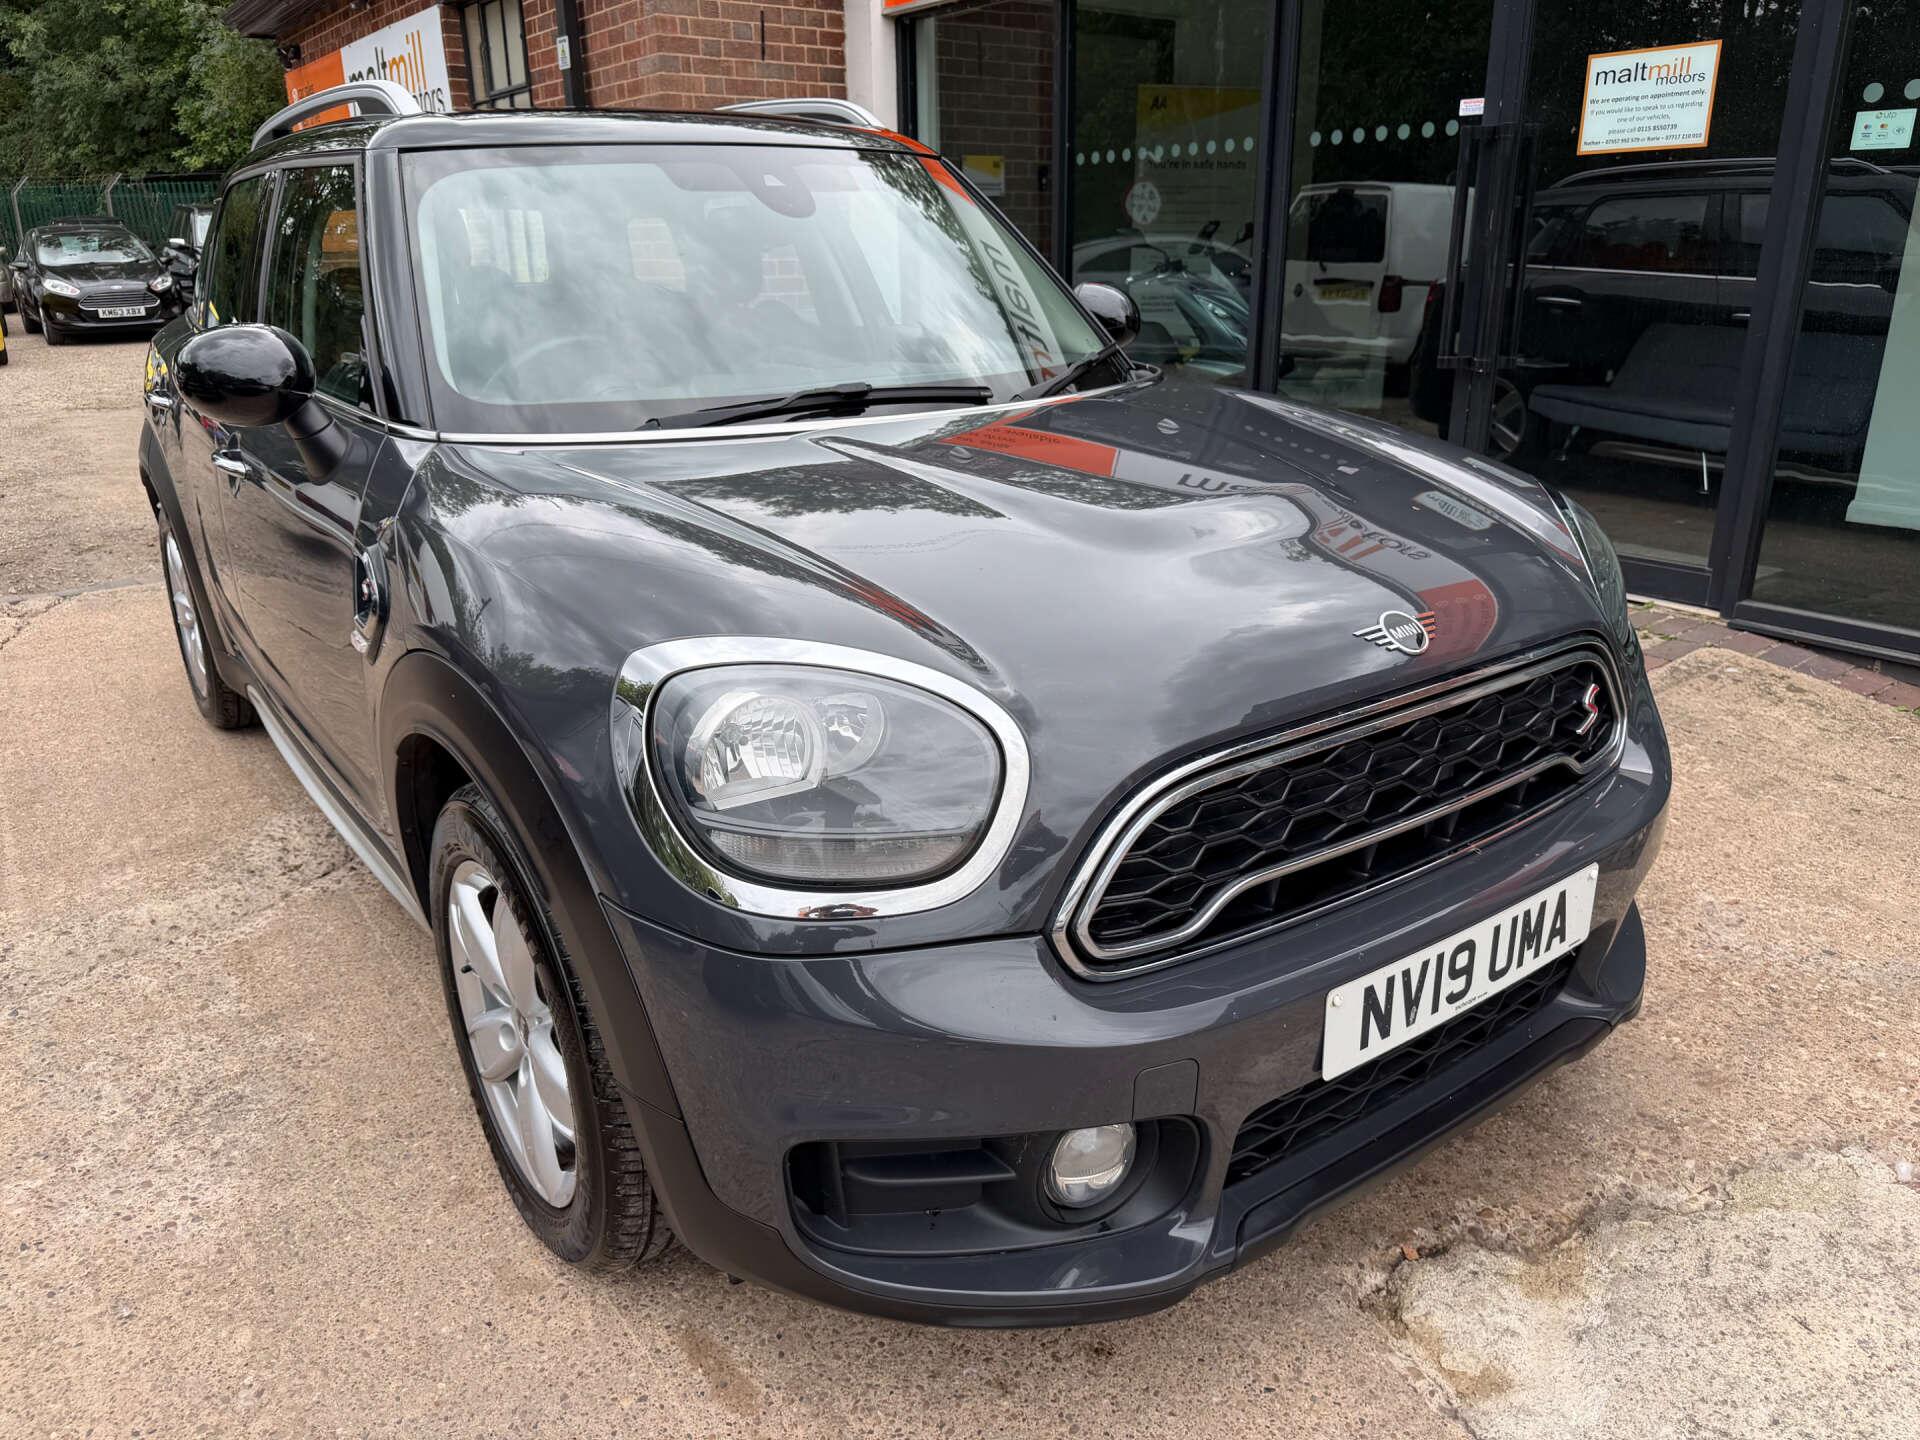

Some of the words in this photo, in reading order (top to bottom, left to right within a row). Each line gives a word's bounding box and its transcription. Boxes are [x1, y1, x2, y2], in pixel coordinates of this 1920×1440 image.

[349, 30, 427, 93] ltmill
[1595, 56, 1692, 86] maltmill
[1655, 72, 1706, 86] motors
[1611, 95, 1640, 103] operating
[1649, 89, 1690, 99] appointment
[1389, 621, 1421, 640] MINI
[1360, 938, 1477, 1051] NV19
[1488, 889, 1567, 982] UMA
